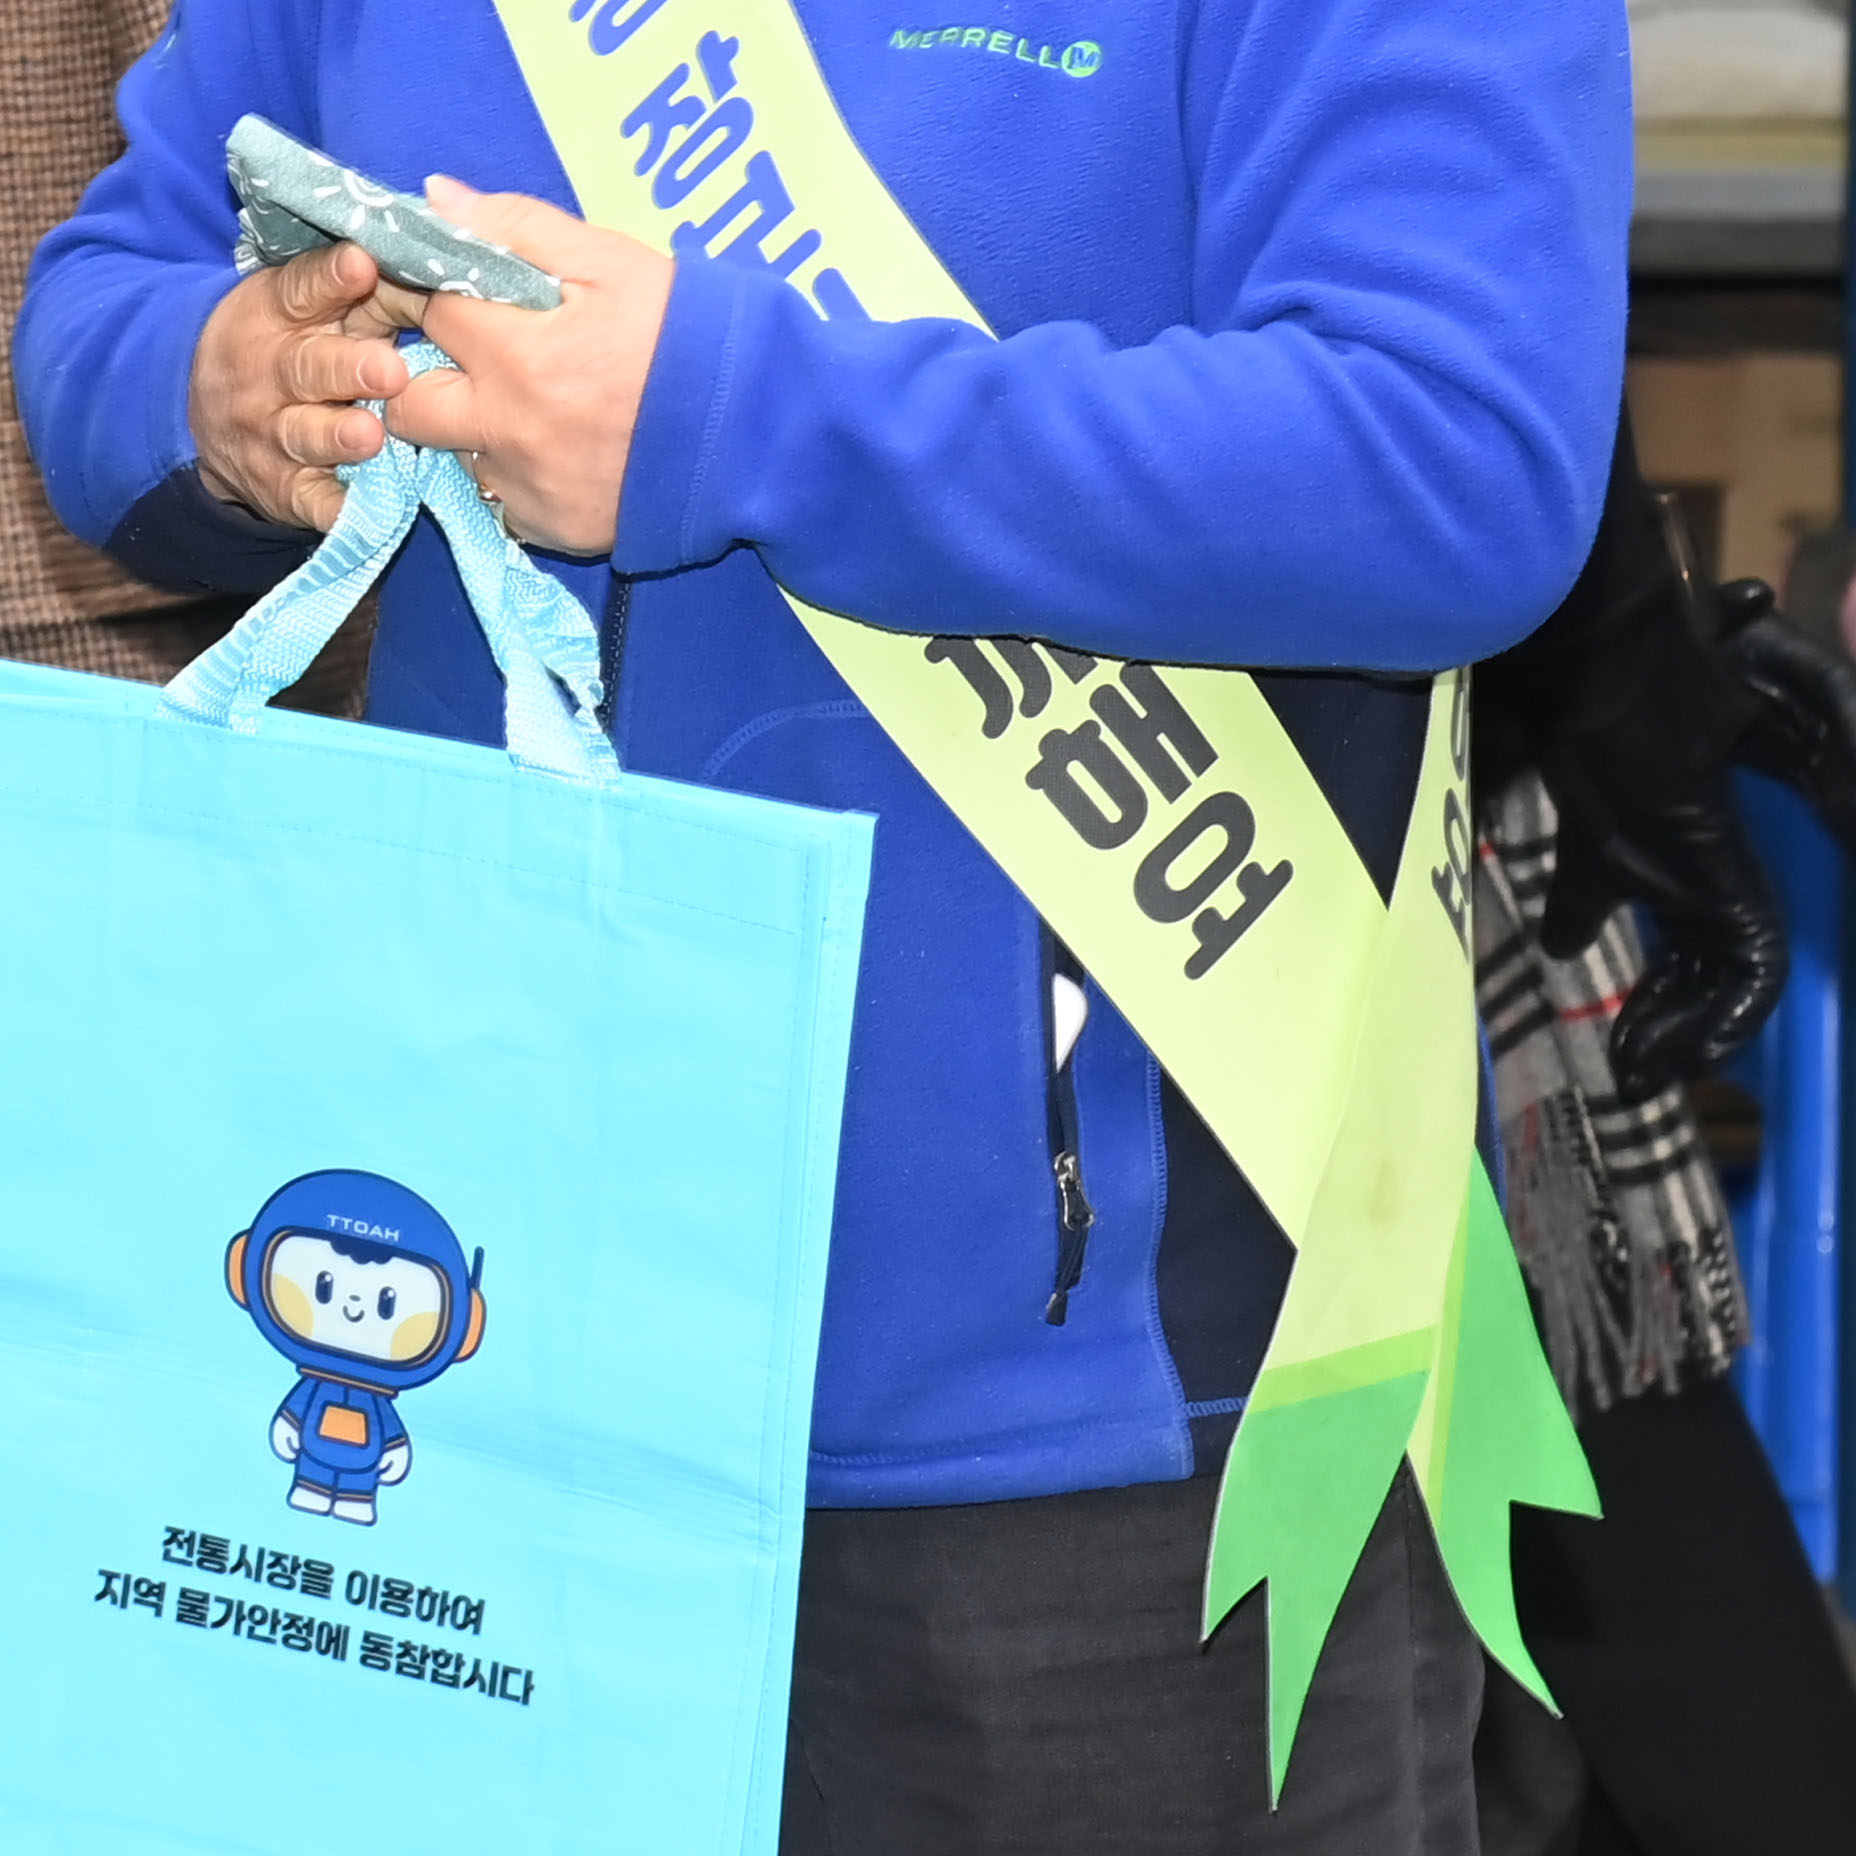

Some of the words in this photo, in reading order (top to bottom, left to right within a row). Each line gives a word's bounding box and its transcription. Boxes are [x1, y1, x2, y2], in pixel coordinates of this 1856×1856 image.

[889, 26, 1061, 70] MERRELL
[619, 29, 873, 322] 장보
[326, 1213, 400, 1242] TTOAH
[162, 1525, 335, 1599] 전통시장을
[345, 1569, 486, 1635] 이용하여
[94, 1569, 167, 1618] 지역
[176, 1586, 351, 1662] 물가안정에
[359, 1630, 535, 1706] 동참합시다
